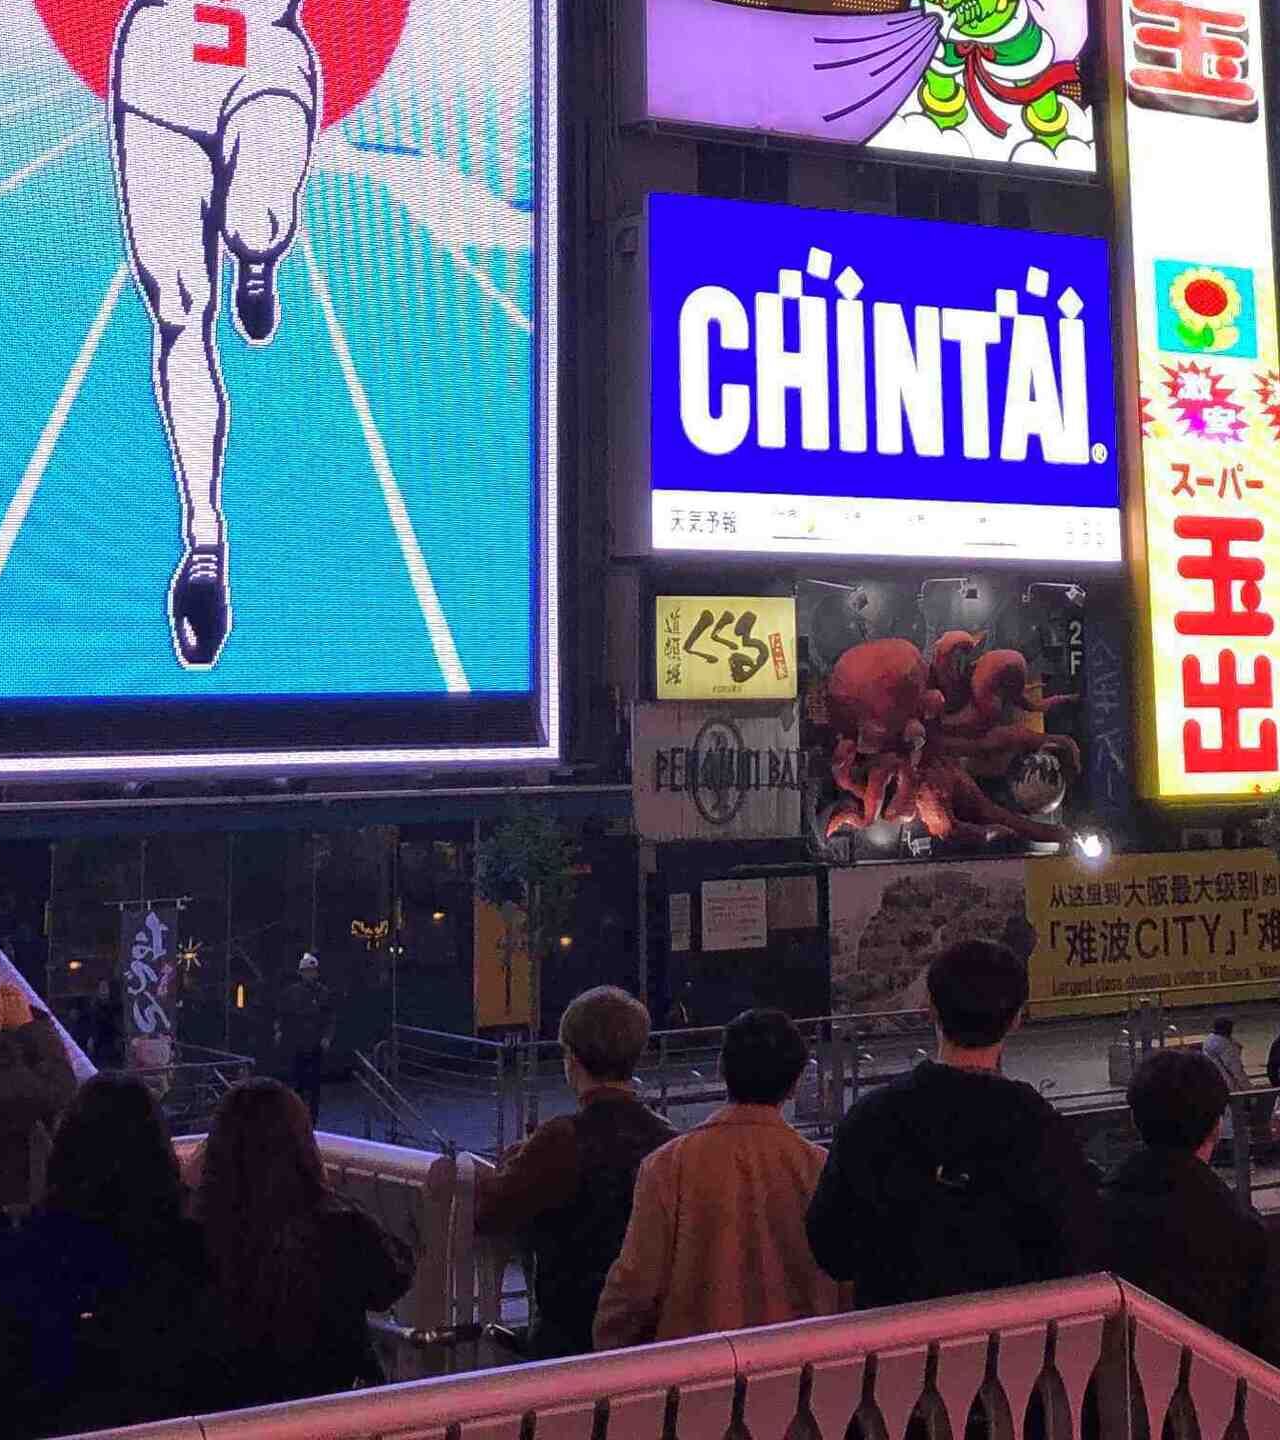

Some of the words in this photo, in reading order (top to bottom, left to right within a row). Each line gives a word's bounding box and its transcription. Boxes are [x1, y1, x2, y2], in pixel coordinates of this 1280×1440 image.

[1171, 463, 1264, 500] スーパー
[1174, 516, 1279, 774] 玉出
